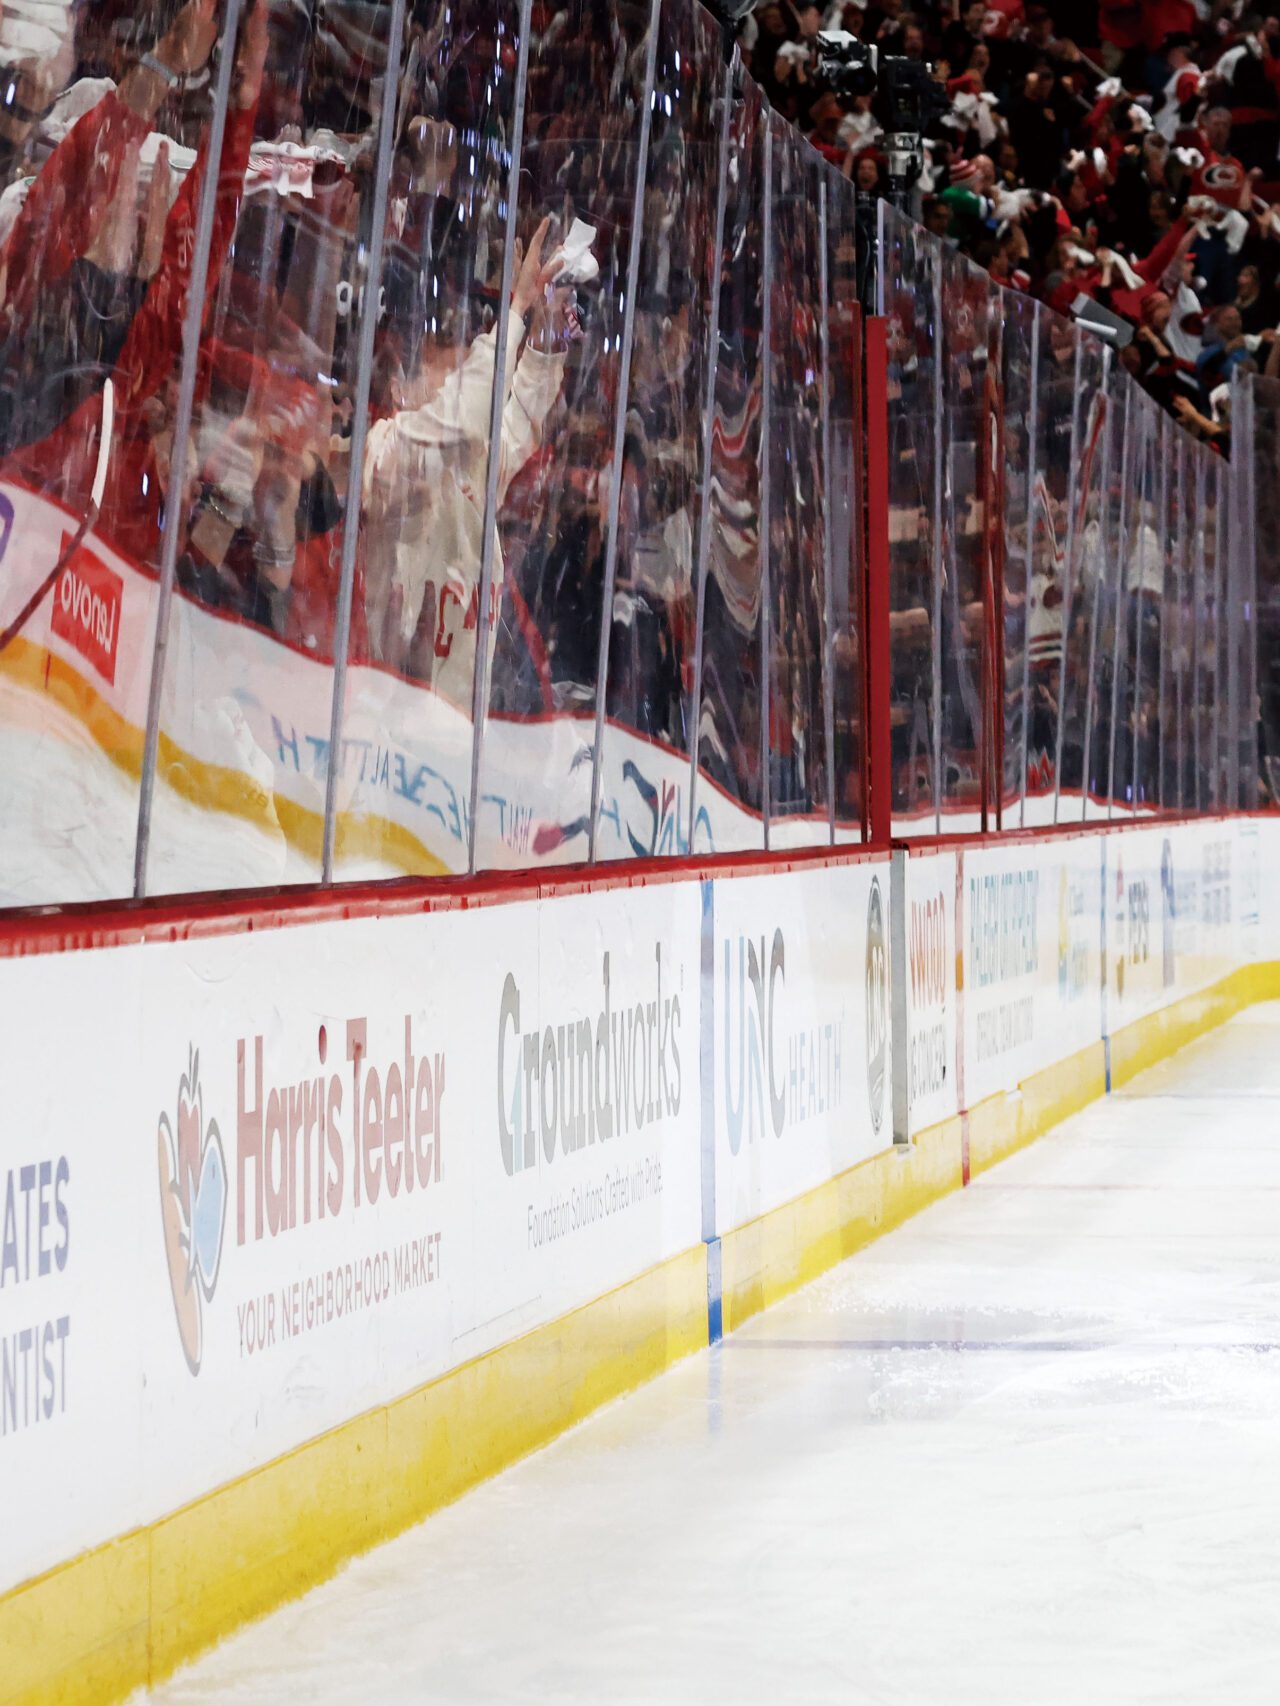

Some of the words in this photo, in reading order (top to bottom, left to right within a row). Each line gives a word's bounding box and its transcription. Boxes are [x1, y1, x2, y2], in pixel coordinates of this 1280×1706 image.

[237, 1024, 343, 1246] Harris
[346, 1014, 445, 1208] Teeter
[498, 942, 681, 1176] Groundworks
[725, 927, 785, 1156] UNC
[237, 1292, 275, 1358] YOUR
[282, 1251, 389, 1340] NEIGHBORHOOD
[394, 1232, 442, 1296] MARKET
